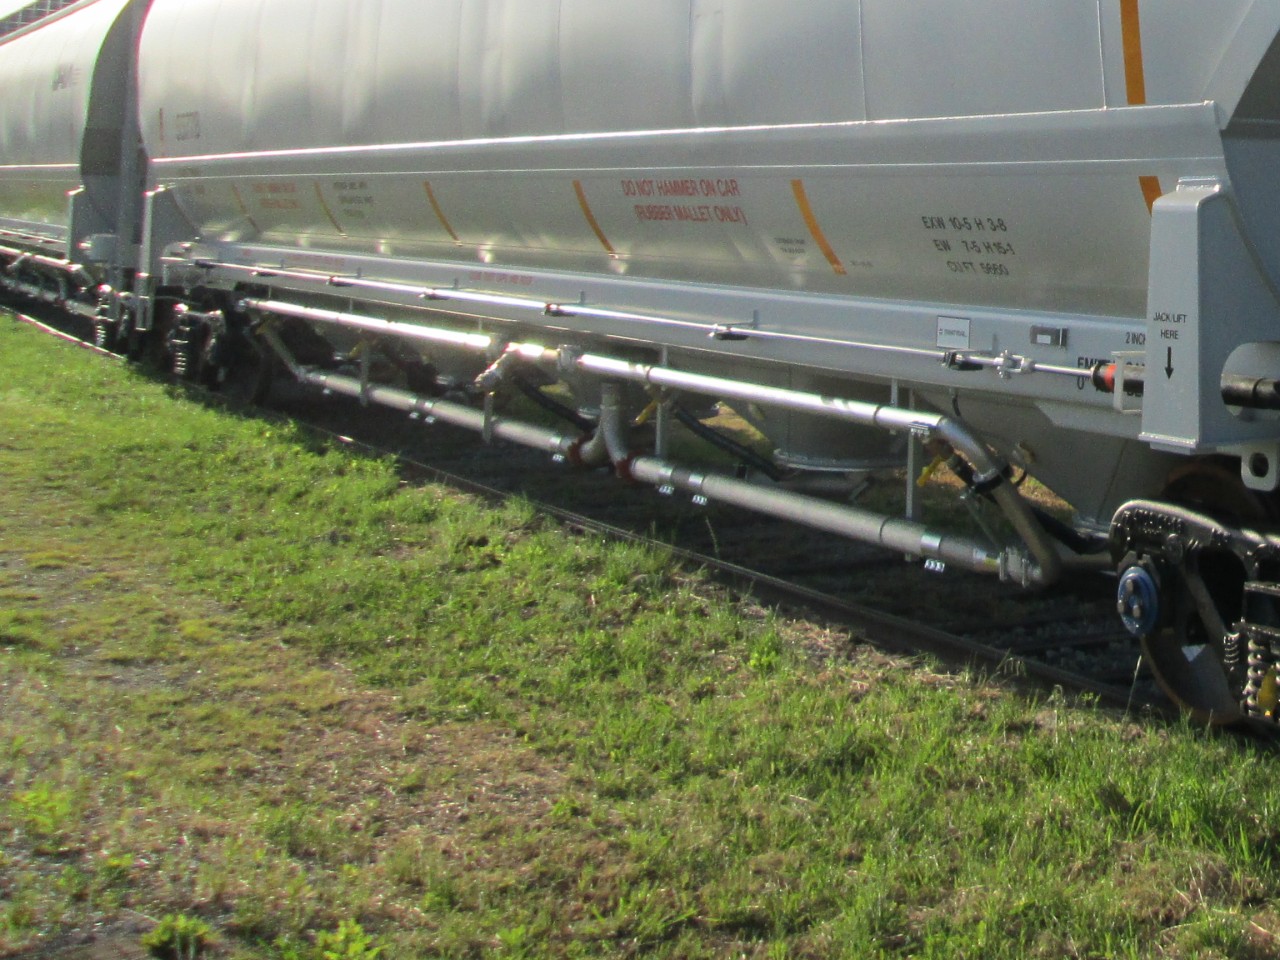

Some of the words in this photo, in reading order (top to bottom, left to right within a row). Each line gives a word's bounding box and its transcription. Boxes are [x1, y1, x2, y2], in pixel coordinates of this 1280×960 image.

[717, 179, 740, 196] CAR
[1125, 331, 1130, 344] 2
[1160, 329, 1179, 340] HERE
